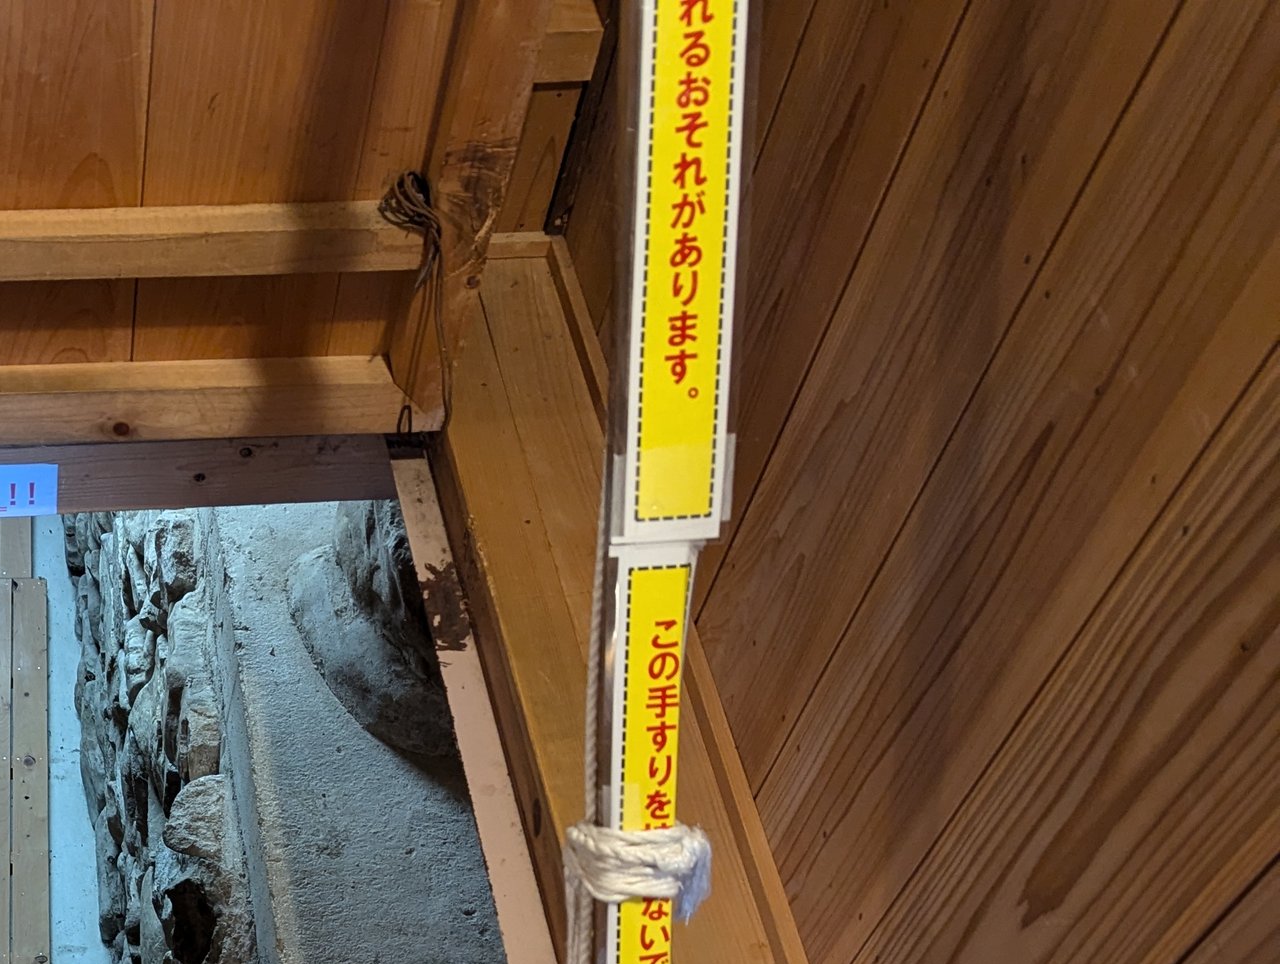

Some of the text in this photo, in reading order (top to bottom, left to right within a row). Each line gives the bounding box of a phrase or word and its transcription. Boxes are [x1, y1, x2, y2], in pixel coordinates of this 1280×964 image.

[665, 0, 715, 399] れるおそれがあります。
